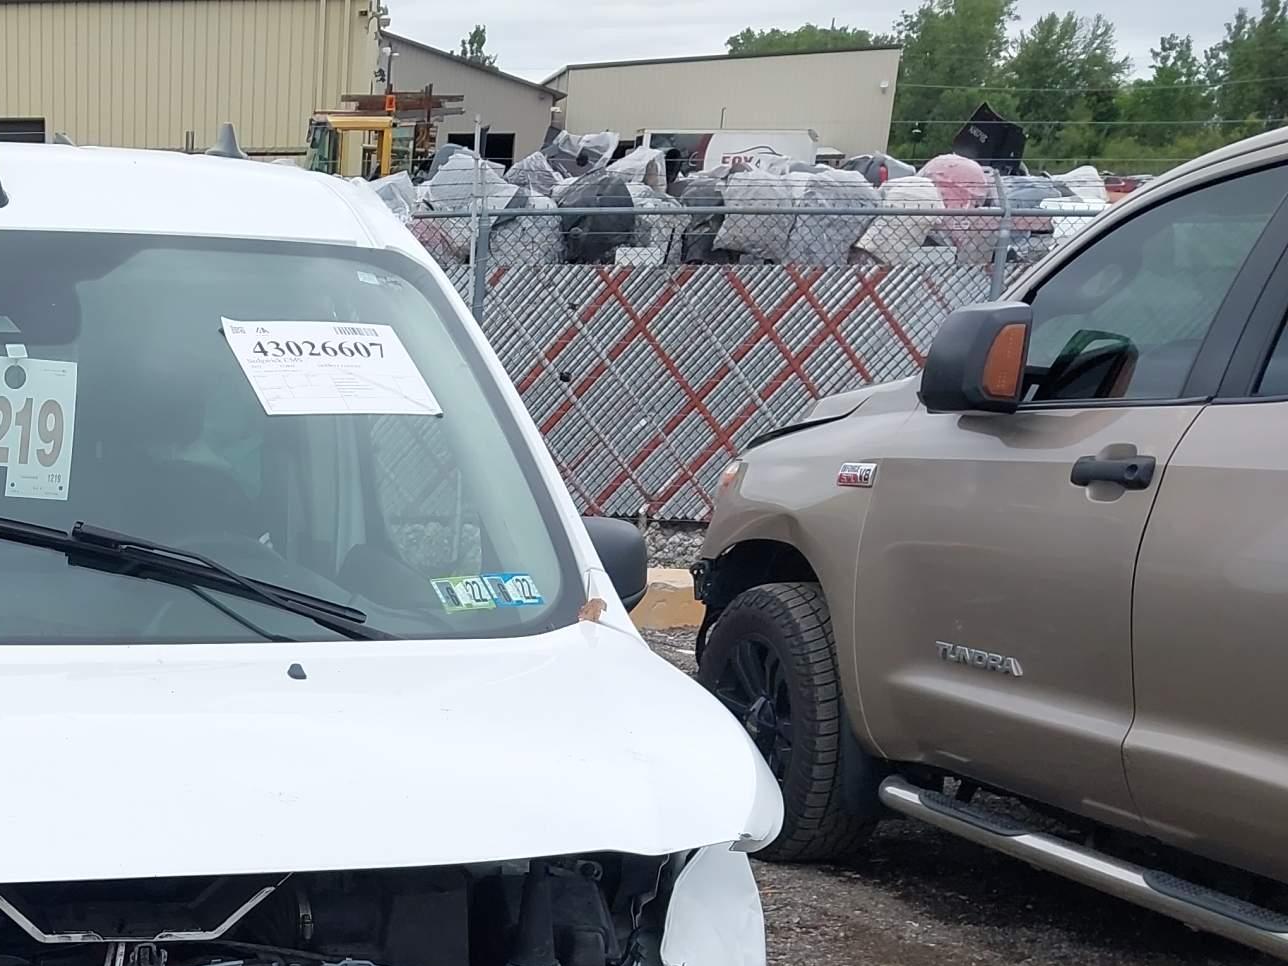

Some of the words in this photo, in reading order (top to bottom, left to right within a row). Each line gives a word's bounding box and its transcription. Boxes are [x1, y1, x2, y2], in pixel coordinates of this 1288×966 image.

[252, 340, 385, 359] 43026607
[47, 473, 62, 484] 1219
[464, 580, 489, 603] 22
[512, 577, 537, 600] 22
[935, 640, 1024, 677] TUNDRA
